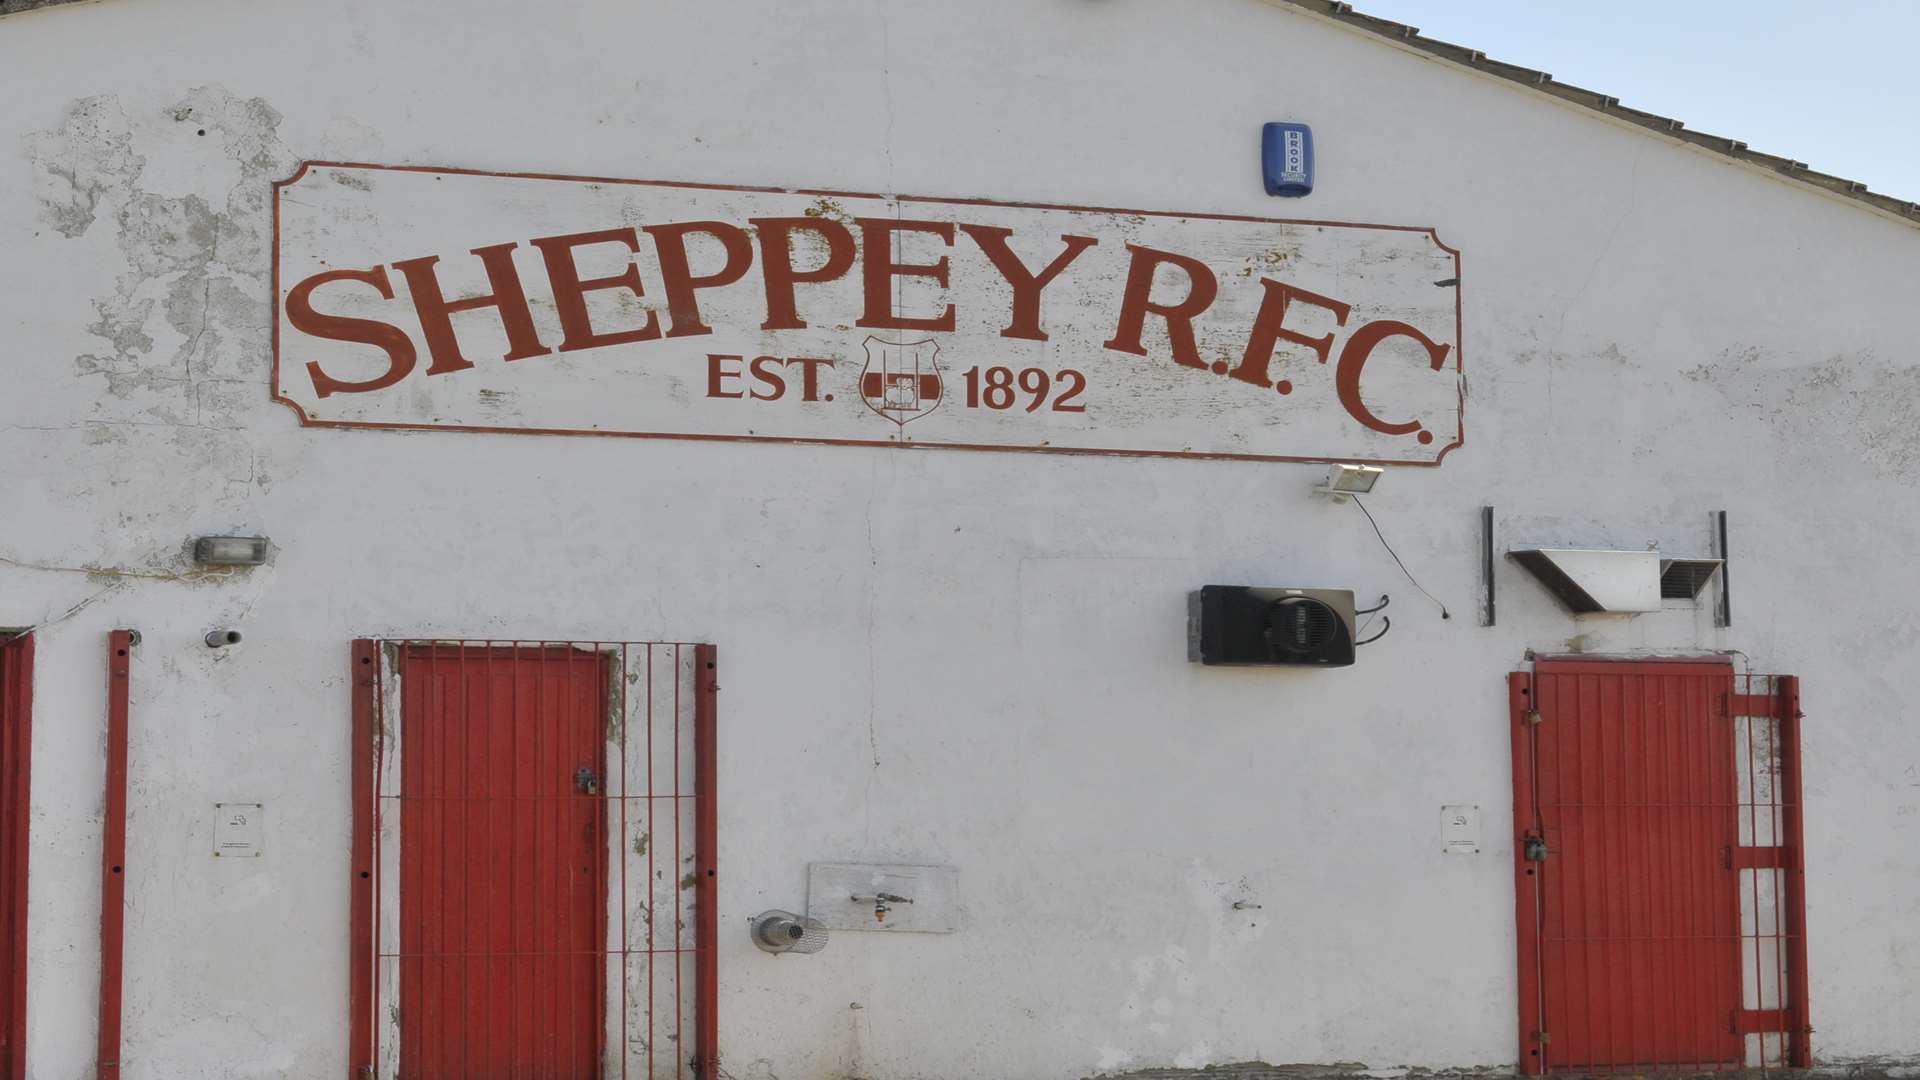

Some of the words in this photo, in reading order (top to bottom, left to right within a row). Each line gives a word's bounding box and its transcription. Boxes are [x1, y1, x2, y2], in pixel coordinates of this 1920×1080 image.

[1290, 132, 1299, 172] BROOK
[285, 217, 1098, 399] SHEPPEY
[1103, 243, 1450, 445] R.F.C.
[706, 354, 835, 402] EST.
[963, 366, 1087, 413] 1892
